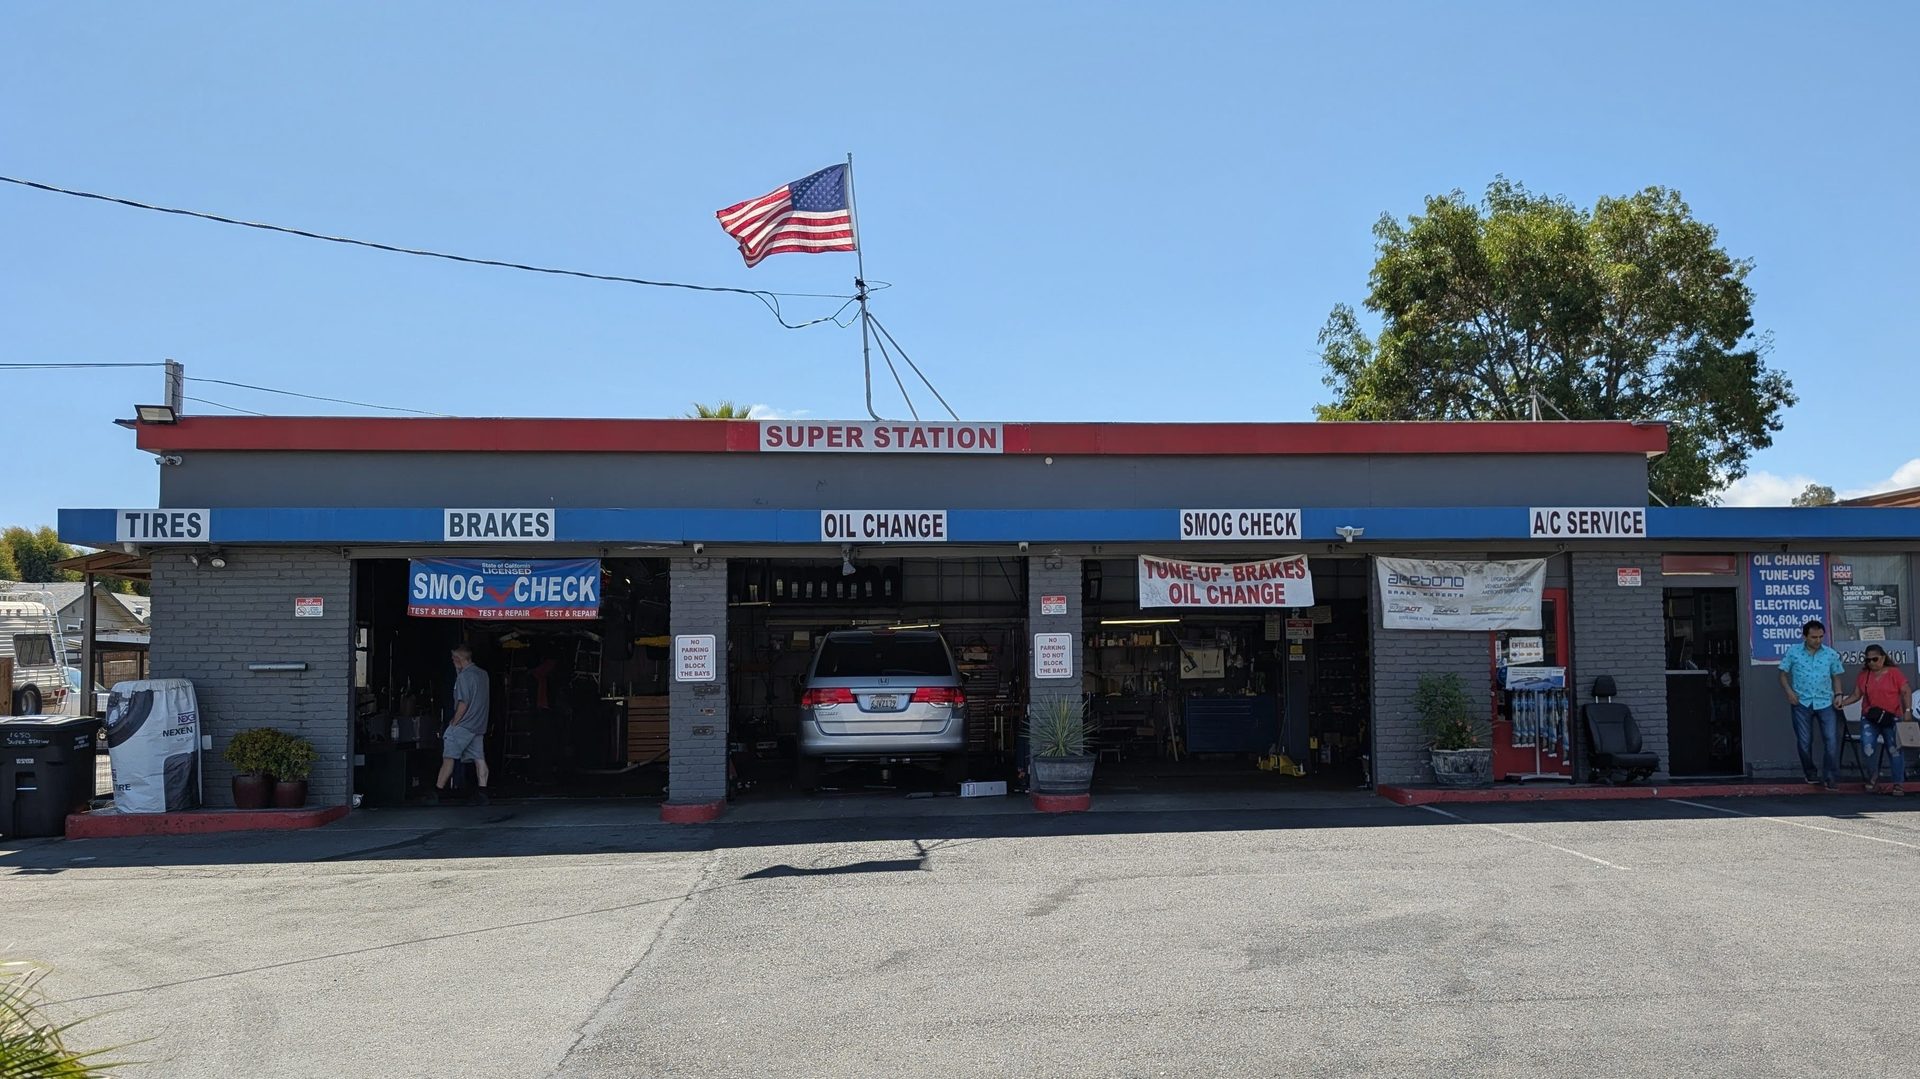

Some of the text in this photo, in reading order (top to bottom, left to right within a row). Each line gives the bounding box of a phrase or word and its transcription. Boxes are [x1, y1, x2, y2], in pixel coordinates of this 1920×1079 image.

[766, 425, 997, 449] SUPER STATION
[125, 512, 202, 538] TIRES
[450, 512, 550, 538] BRAKES
[824, 513, 944, 538] OIL CHANGE
[1183, 512, 1298, 537] SMOG CHECK
[1533, 511, 1644, 535] A/C SERVICE
[1143, 558, 1306, 582] TUNE-UP BRAKES
[1754, 555, 1820, 566] OIL CHANGE
[414, 572, 596, 602] SMOG CHECK
[1760, 570, 1815, 580] TUNE-UPS
[1168, 582, 1286, 605] OIL CHANGE
[1765, 585, 1810, 595] BRAKES
[1754, 600, 1822, 610] ELECTRICAL
[1762, 628, 1803, 639] SERVIC
[162, 726, 193, 737] NEXEN
